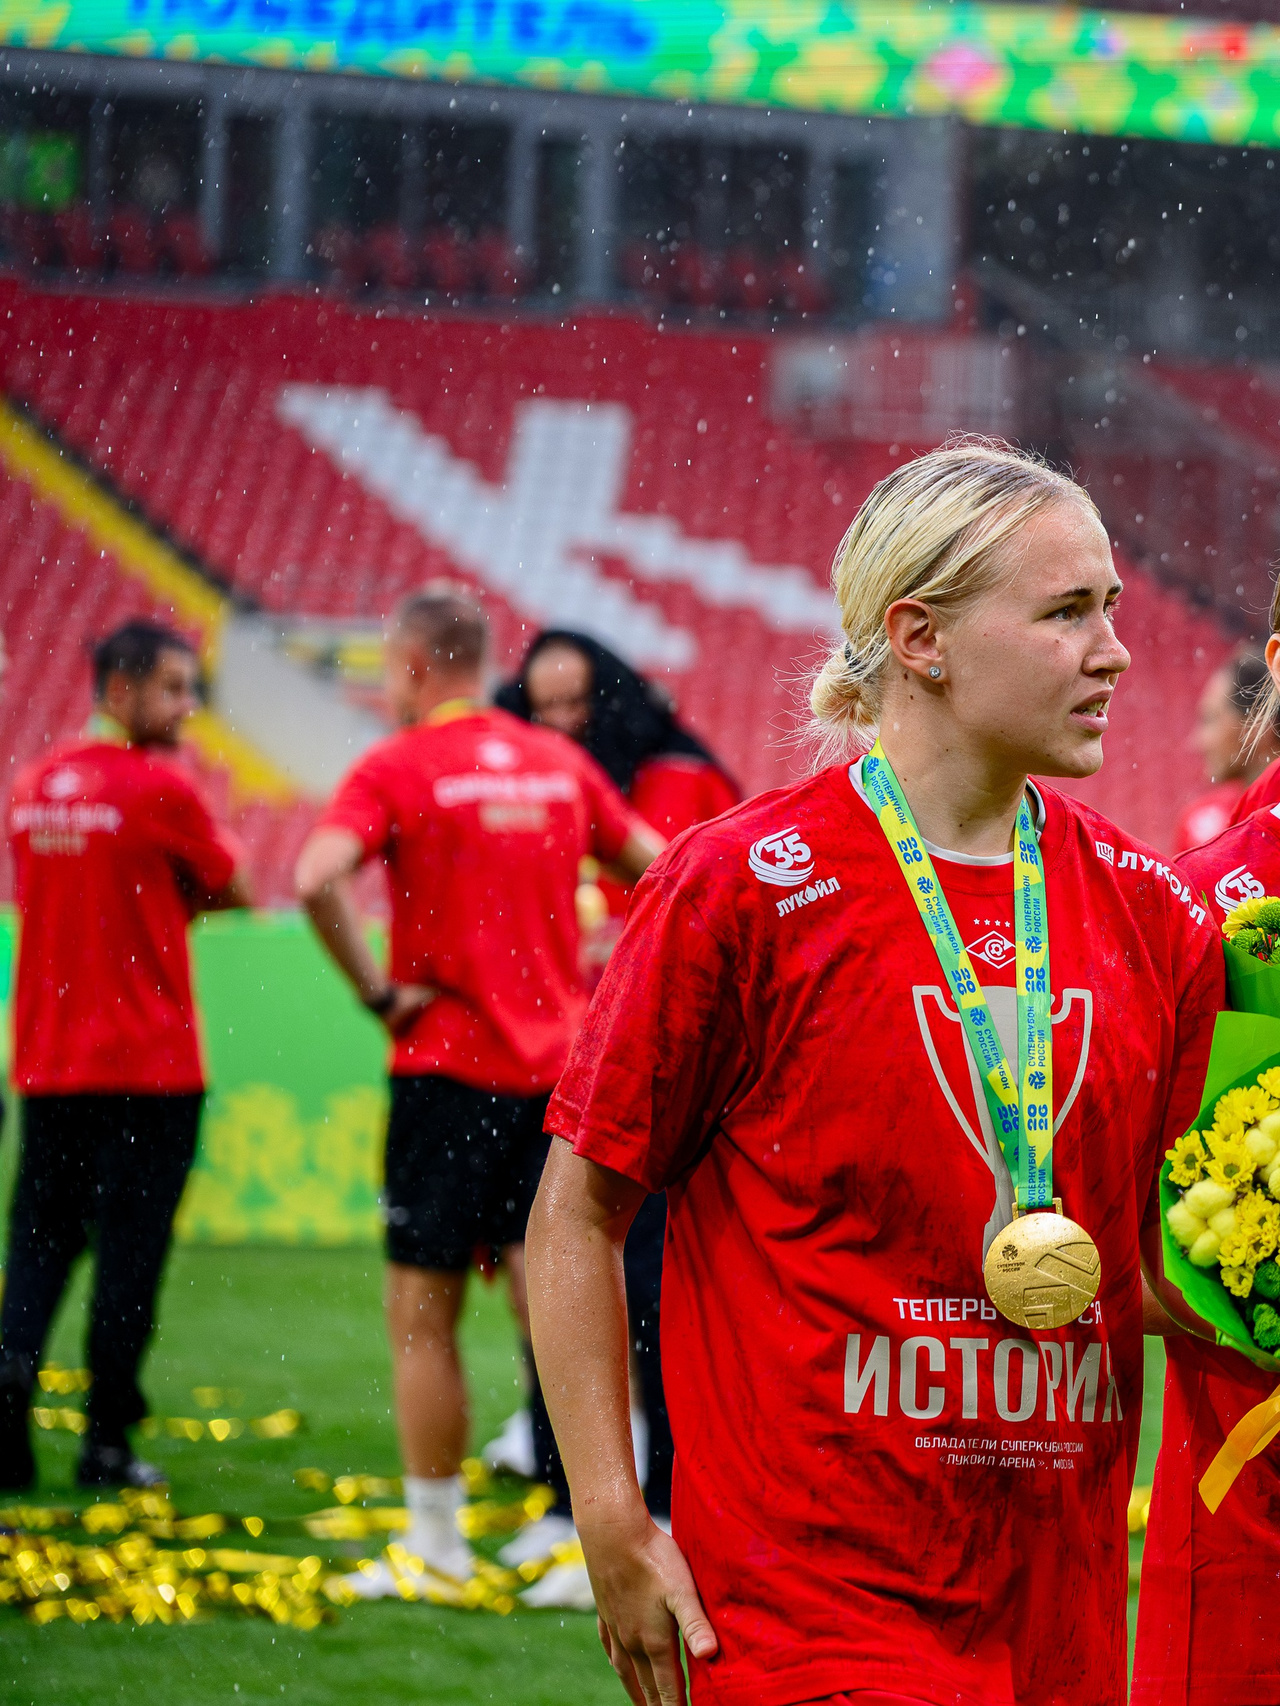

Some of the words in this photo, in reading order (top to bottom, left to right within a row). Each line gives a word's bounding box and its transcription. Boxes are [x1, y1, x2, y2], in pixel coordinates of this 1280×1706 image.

[870, 776, 889, 808] РОССИИ
[763, 832, 812, 869] 35
[1226, 871, 1266, 900] 35
[923, 897, 944, 935] РОССИИ
[1033, 898, 1042, 933] РОССИИ
[976, 1030, 995, 1069] РОССИИ
[1037, 1029, 1046, 1068] РОССИИ
[893, 1297, 997, 1322] ТЕПЕРЬ
[914, 1436, 998, 1450] ОБЛАДАТЕЛИ
